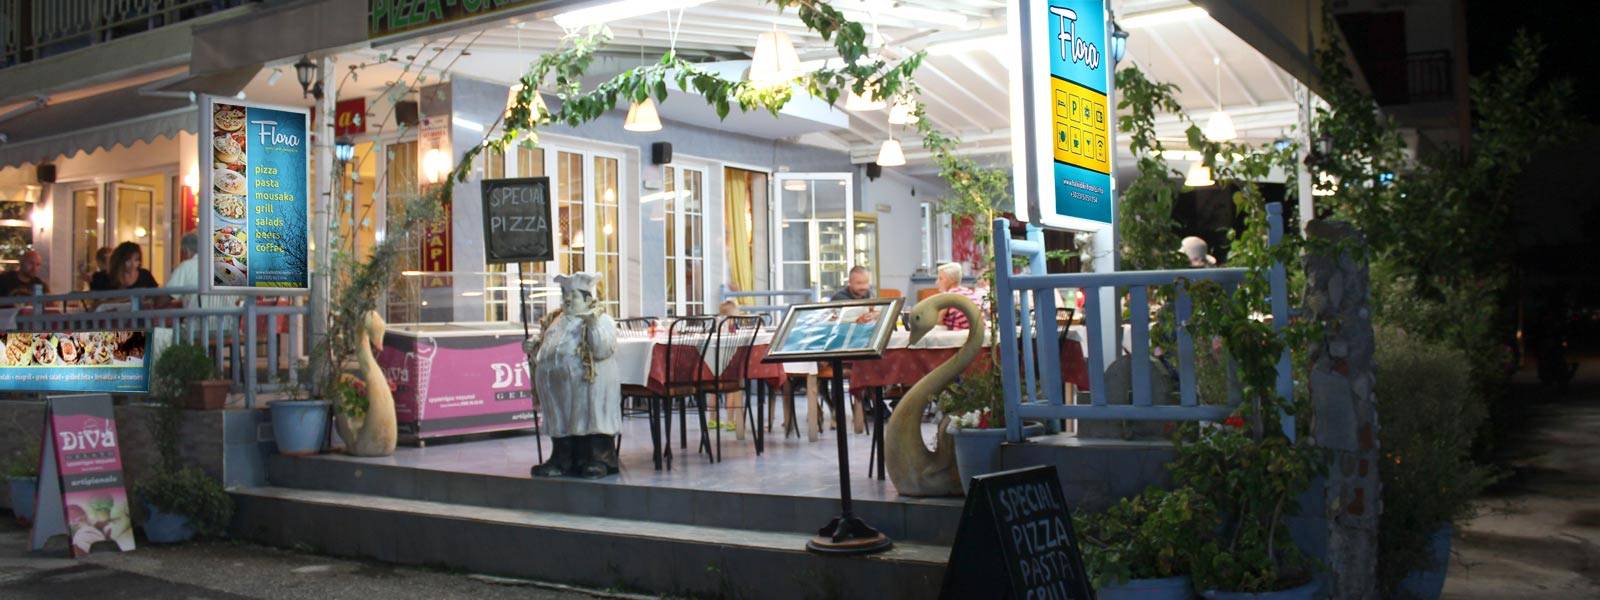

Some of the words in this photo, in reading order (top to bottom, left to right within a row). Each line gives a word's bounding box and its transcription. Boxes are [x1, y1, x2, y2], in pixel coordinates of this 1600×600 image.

[1050, 5, 1100, 70] Flora
[250, 120, 300, 147] Flora
[255, 165, 278, 175] pizza
[255, 179, 280, 188] pasta
[255, 192, 294, 201] mousaka
[489, 186, 546, 207] SPECIAL
[255, 203, 273, 214] grill
[255, 217, 284, 226] salads
[491, 215, 548, 233] PIZZA
[255, 229, 281, 239] beers
[255, 242, 285, 252] coffee
[999, 482, 1060, 522] SPECIAL
[1011, 516, 1071, 555] PIZZA
[1019, 550, 1075, 587] PASTA
